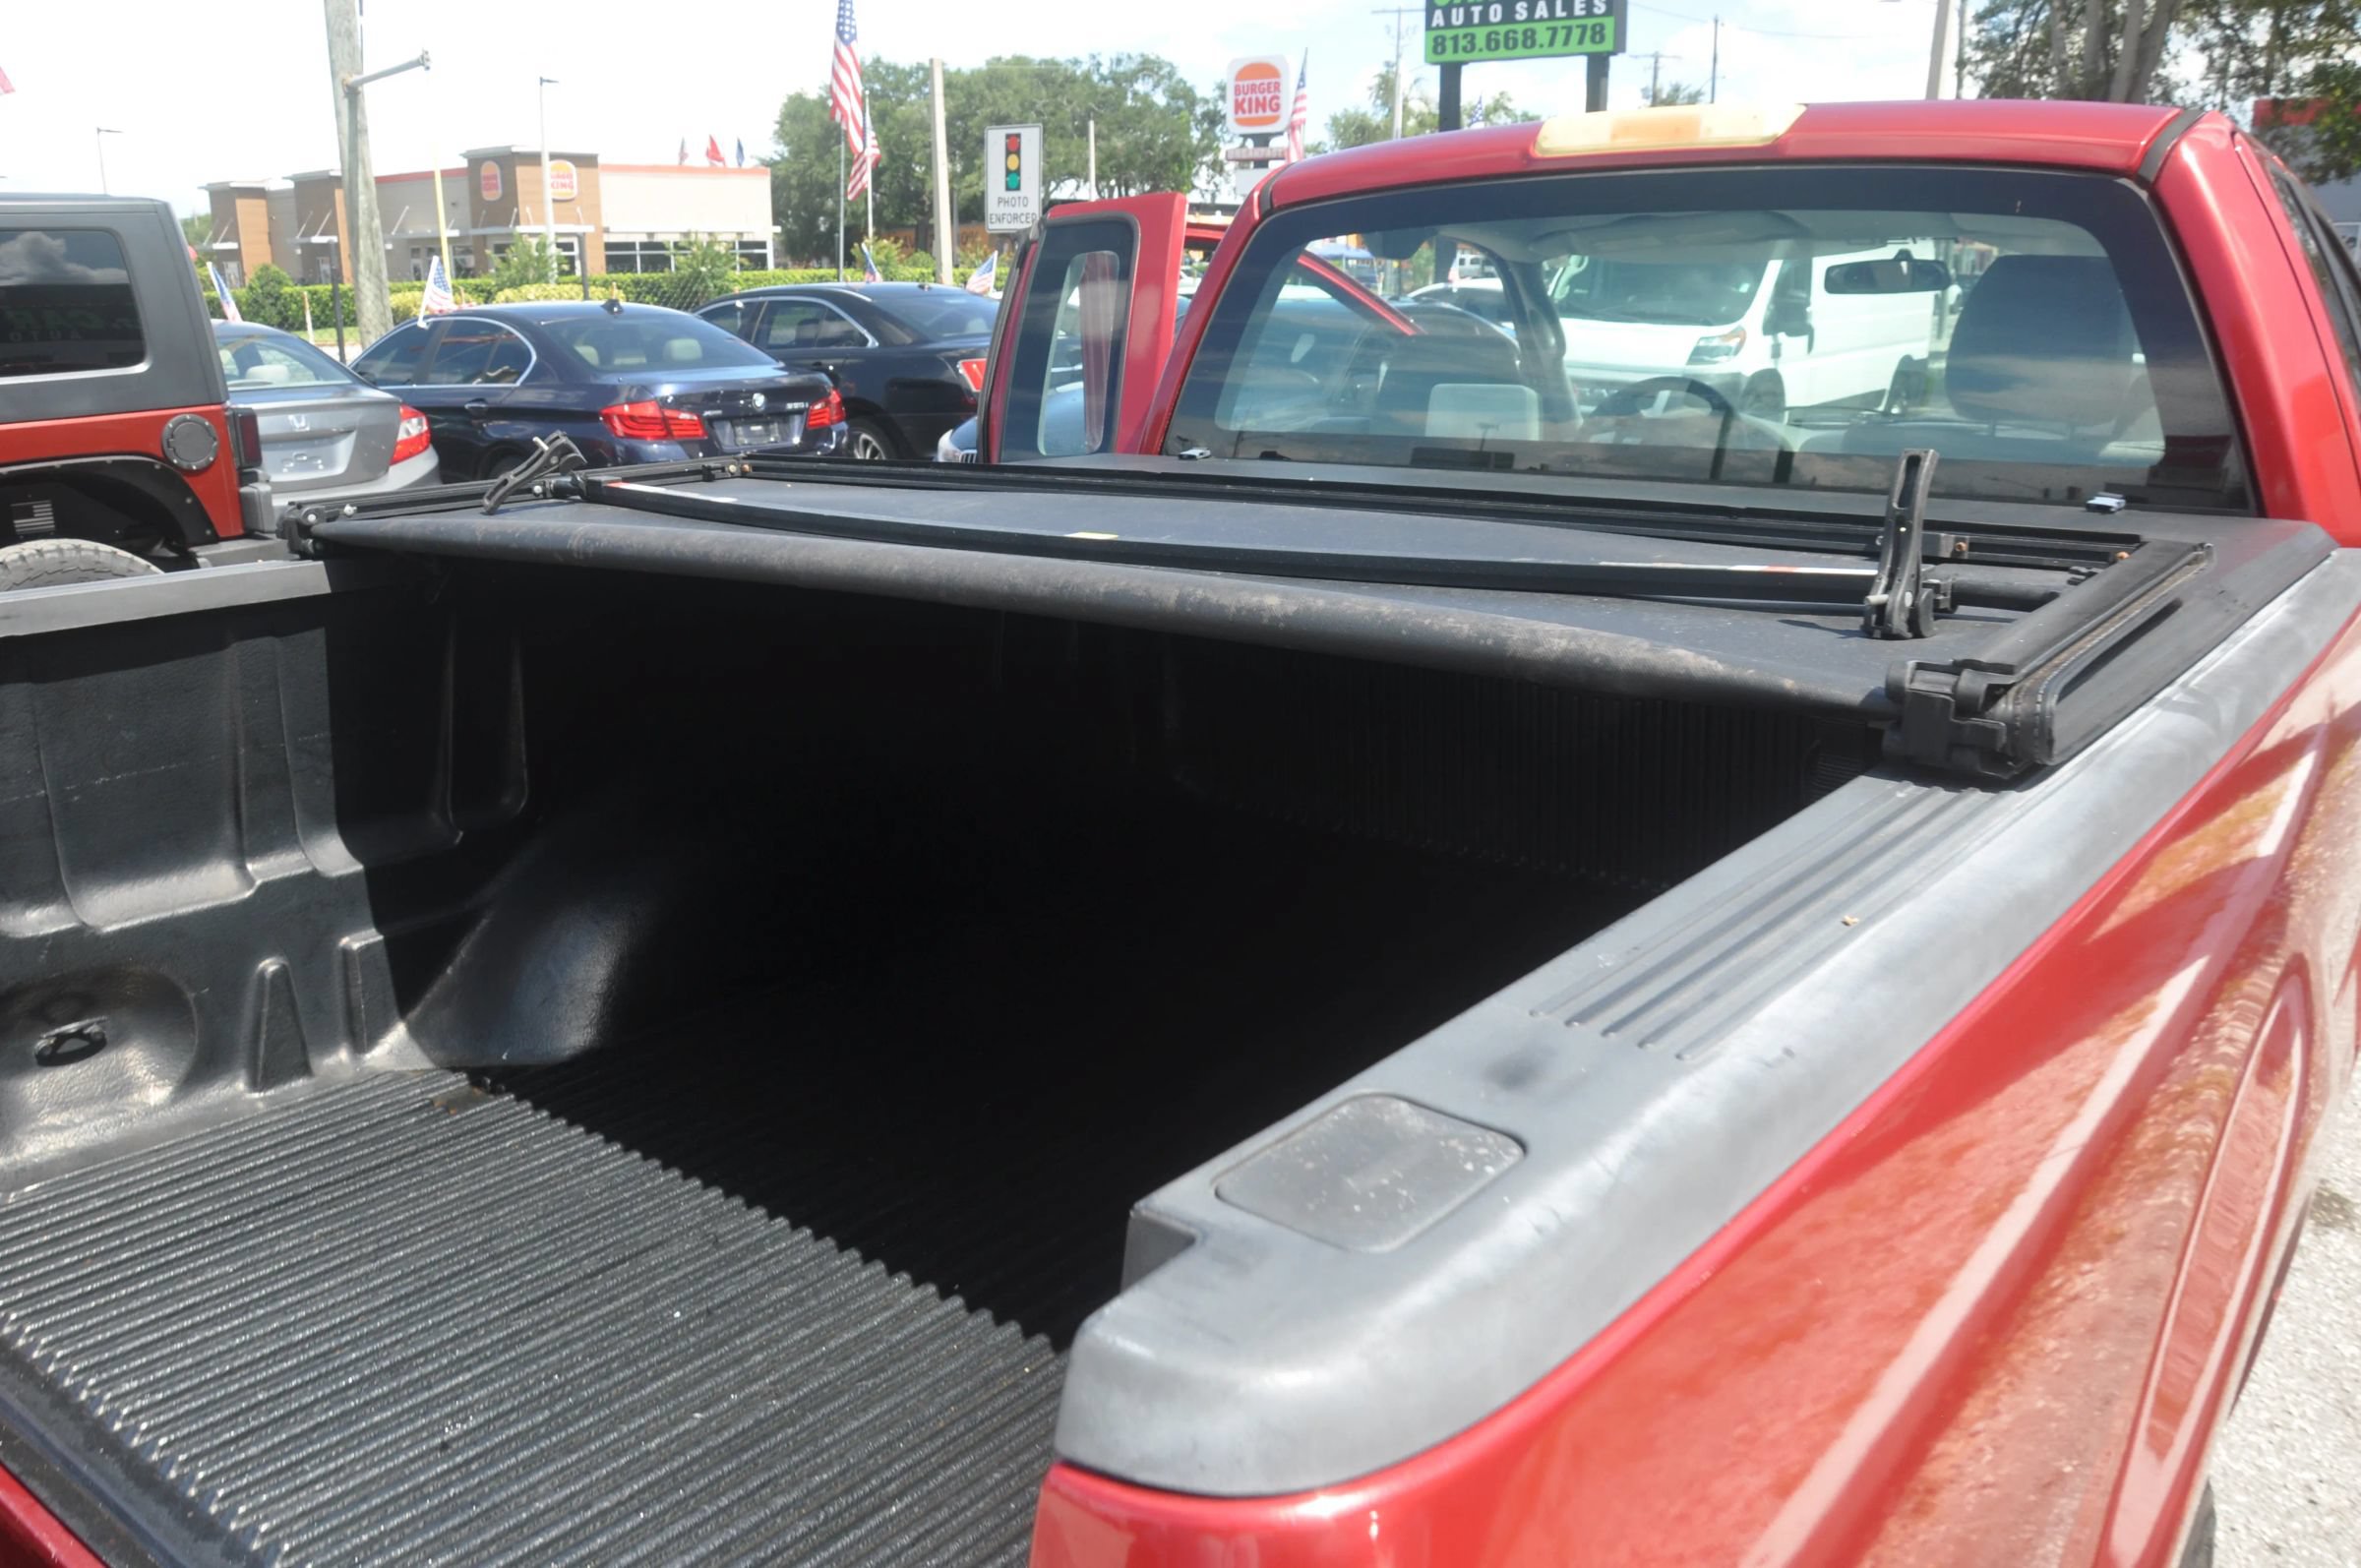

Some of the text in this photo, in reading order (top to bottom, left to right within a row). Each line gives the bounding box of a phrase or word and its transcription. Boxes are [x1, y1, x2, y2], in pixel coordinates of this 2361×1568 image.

[1430, 0, 1607, 28] AUTO SALES
[1432, 23, 1606, 56] 813.668.7778
[1235, 82, 1281, 96] BURGER
[1235, 94, 1281, 115] KING
[998, 196, 1029, 208] PHOTO
[989, 212, 1037, 224] ENFORCED
